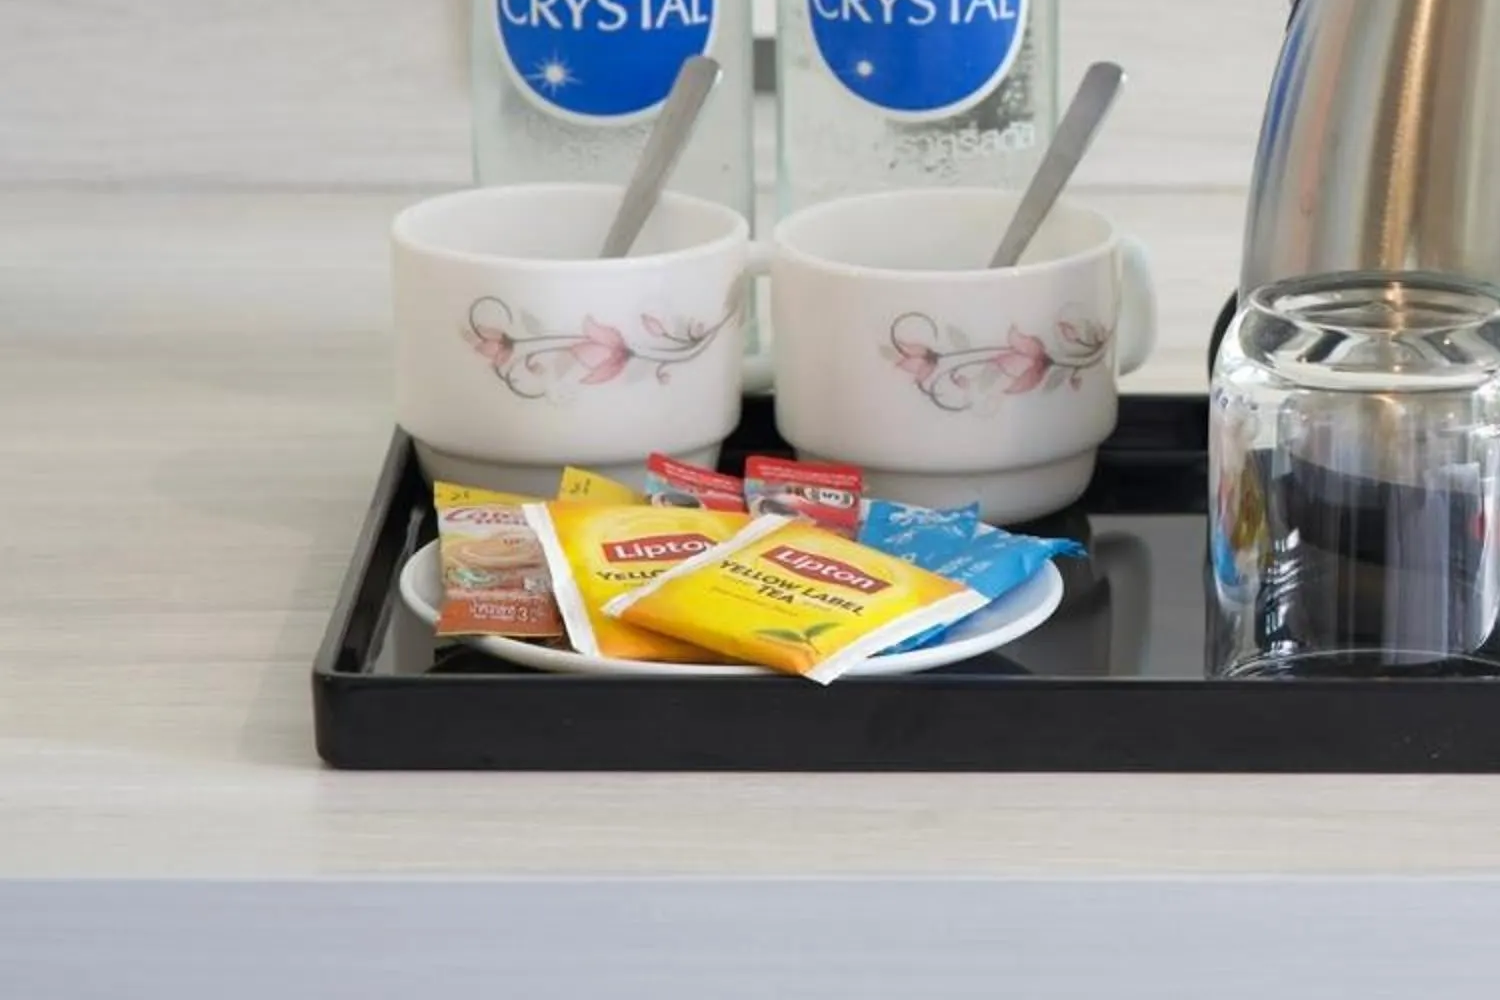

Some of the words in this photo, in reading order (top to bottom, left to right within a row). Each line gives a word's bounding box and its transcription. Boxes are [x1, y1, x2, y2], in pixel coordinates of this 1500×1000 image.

[719, 559, 801, 591] YELLOW
[801, 587, 865, 617] LABEL
[774, 549, 876, 590] Lipton
[755, 584, 796, 606] TEA
